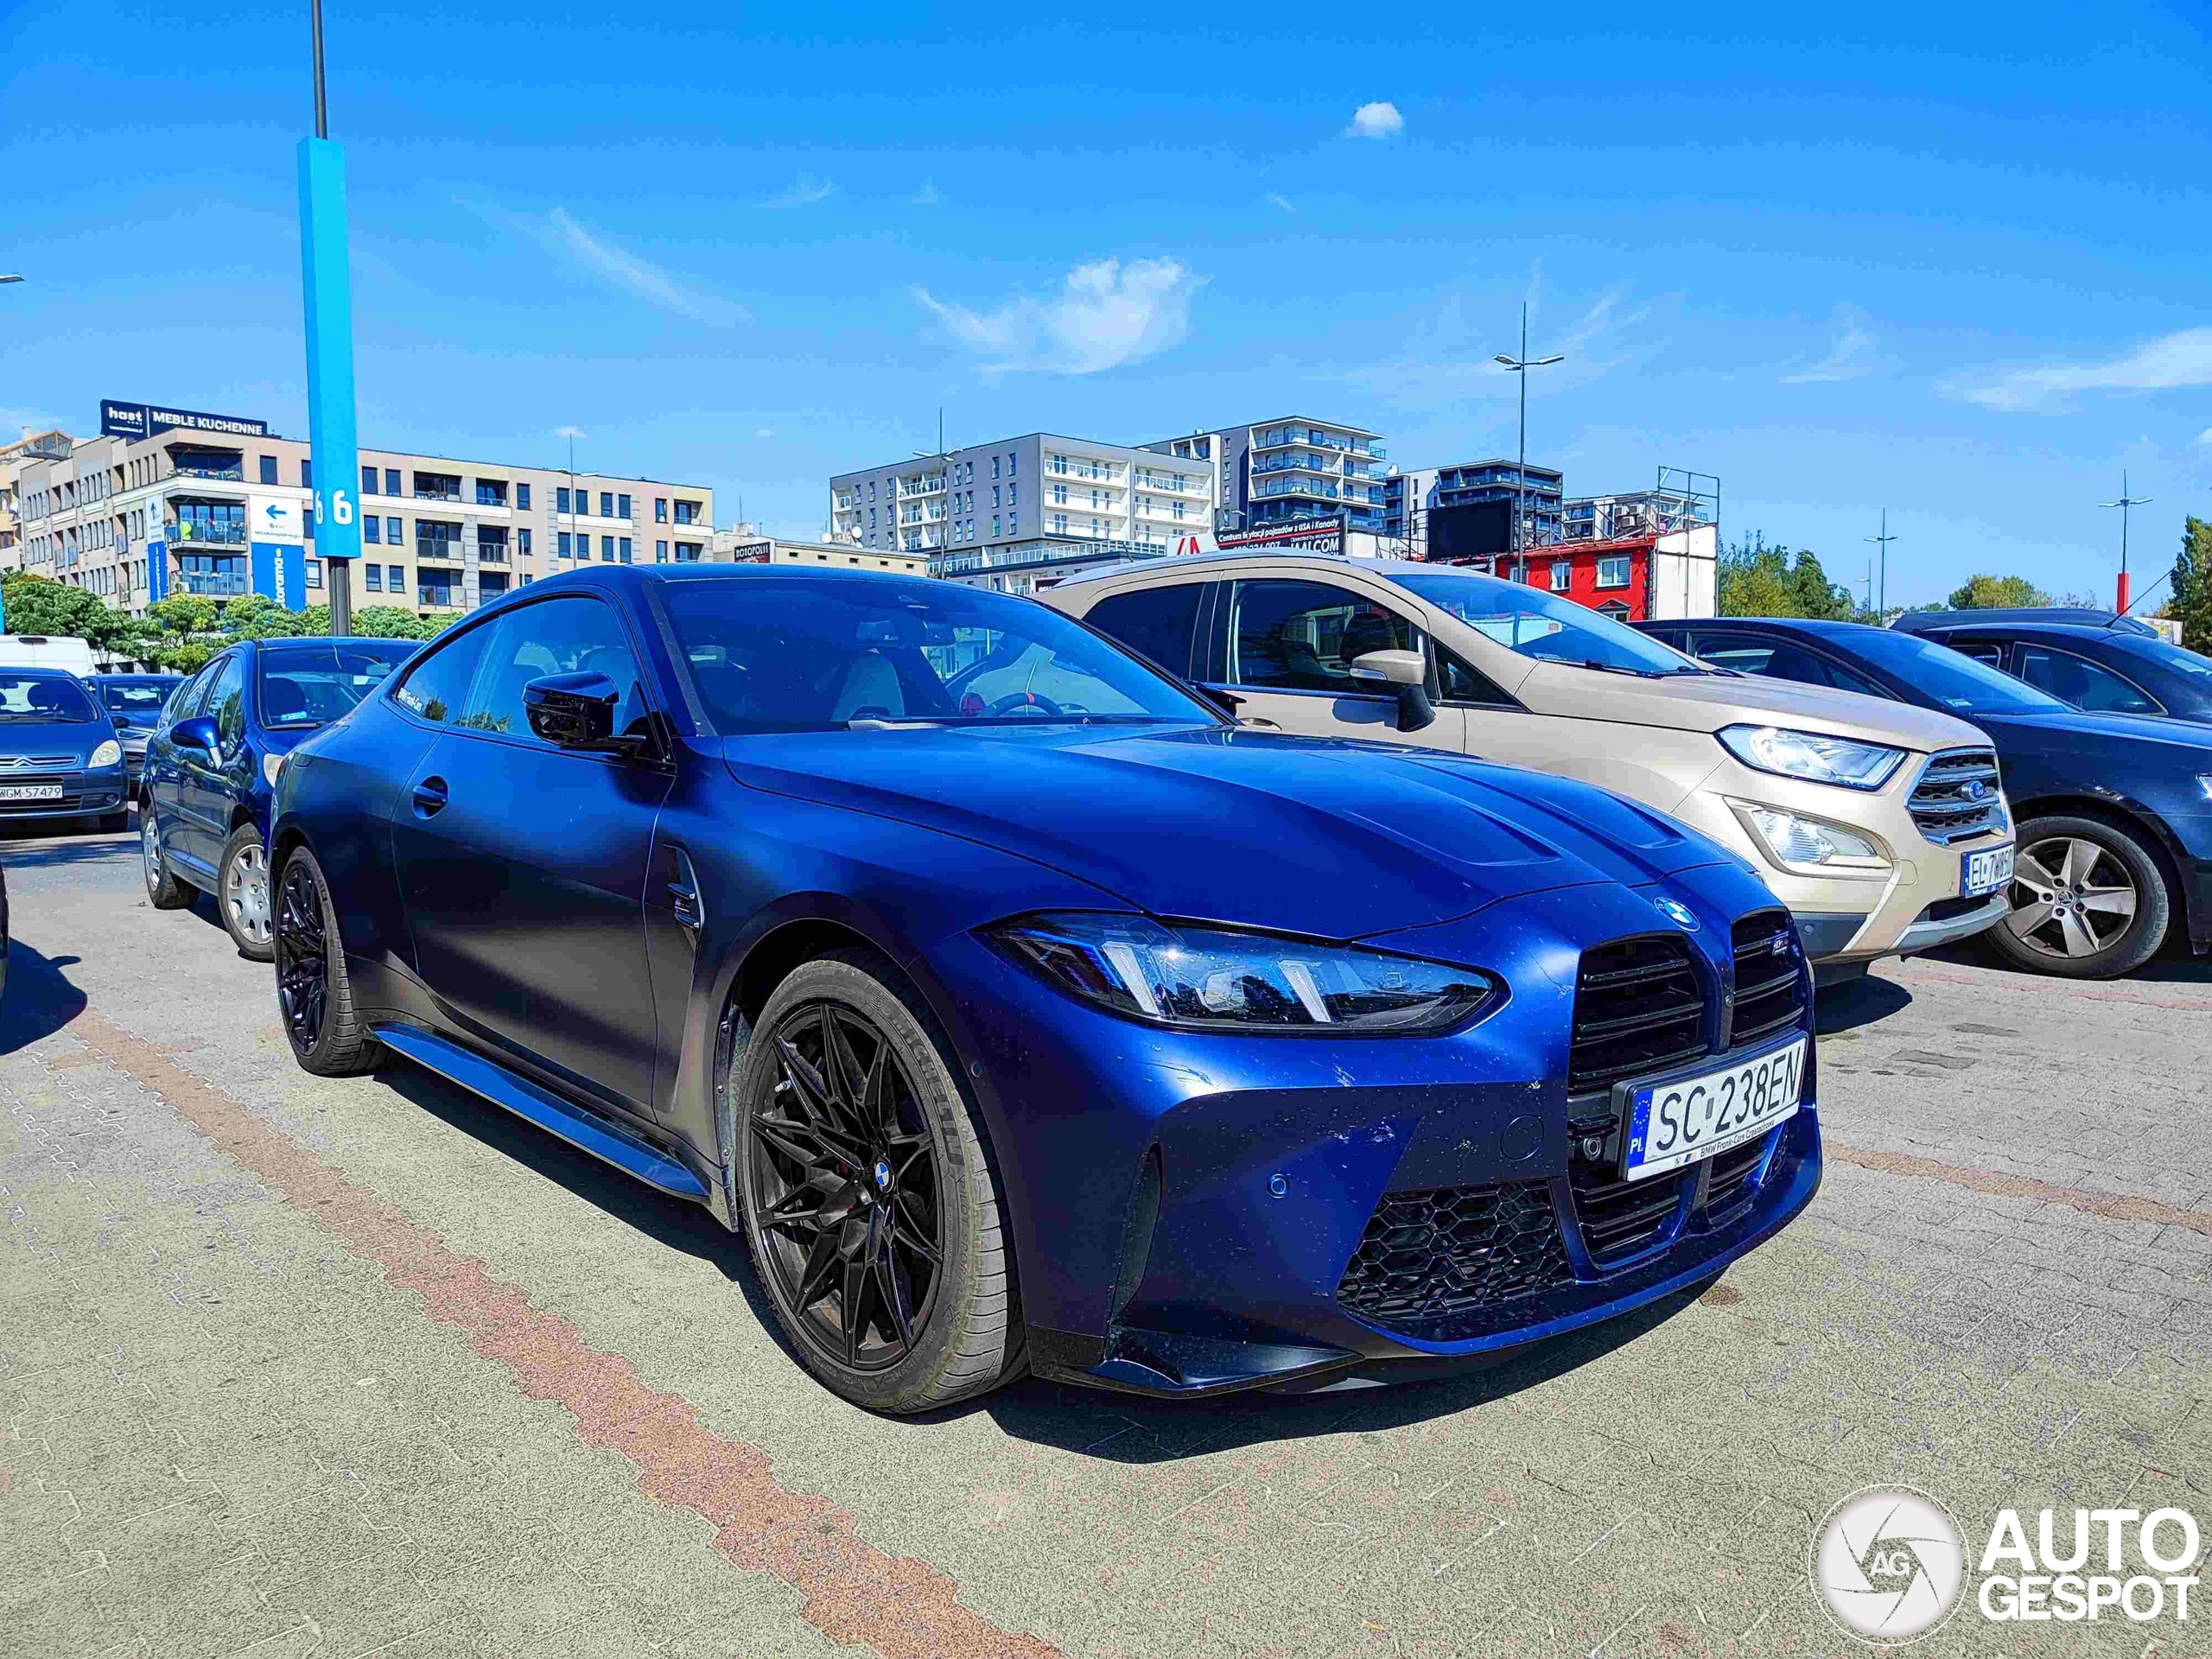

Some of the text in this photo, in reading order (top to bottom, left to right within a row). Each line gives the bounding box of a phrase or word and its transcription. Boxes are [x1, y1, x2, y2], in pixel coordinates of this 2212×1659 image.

[108, 407, 143, 422] hast
[152, 411, 263, 435] MEBLE KUCHENNE
[332, 489, 354, 525] 6
[1217, 532, 1242, 543] Centrum
[1299, 522, 1311, 531] USA
[1314, 518, 1339, 529] Kanady
[25, 786, 61, 798] 57479
[1971, 857, 1986, 887] EL
[1656, 1046, 1801, 1151] SC 238EN
[1630, 1136, 1643, 1154] PL
[1700, 1145, 1717, 1158] BMW
[1717, 1134, 1745, 1152] Frank-Cars
